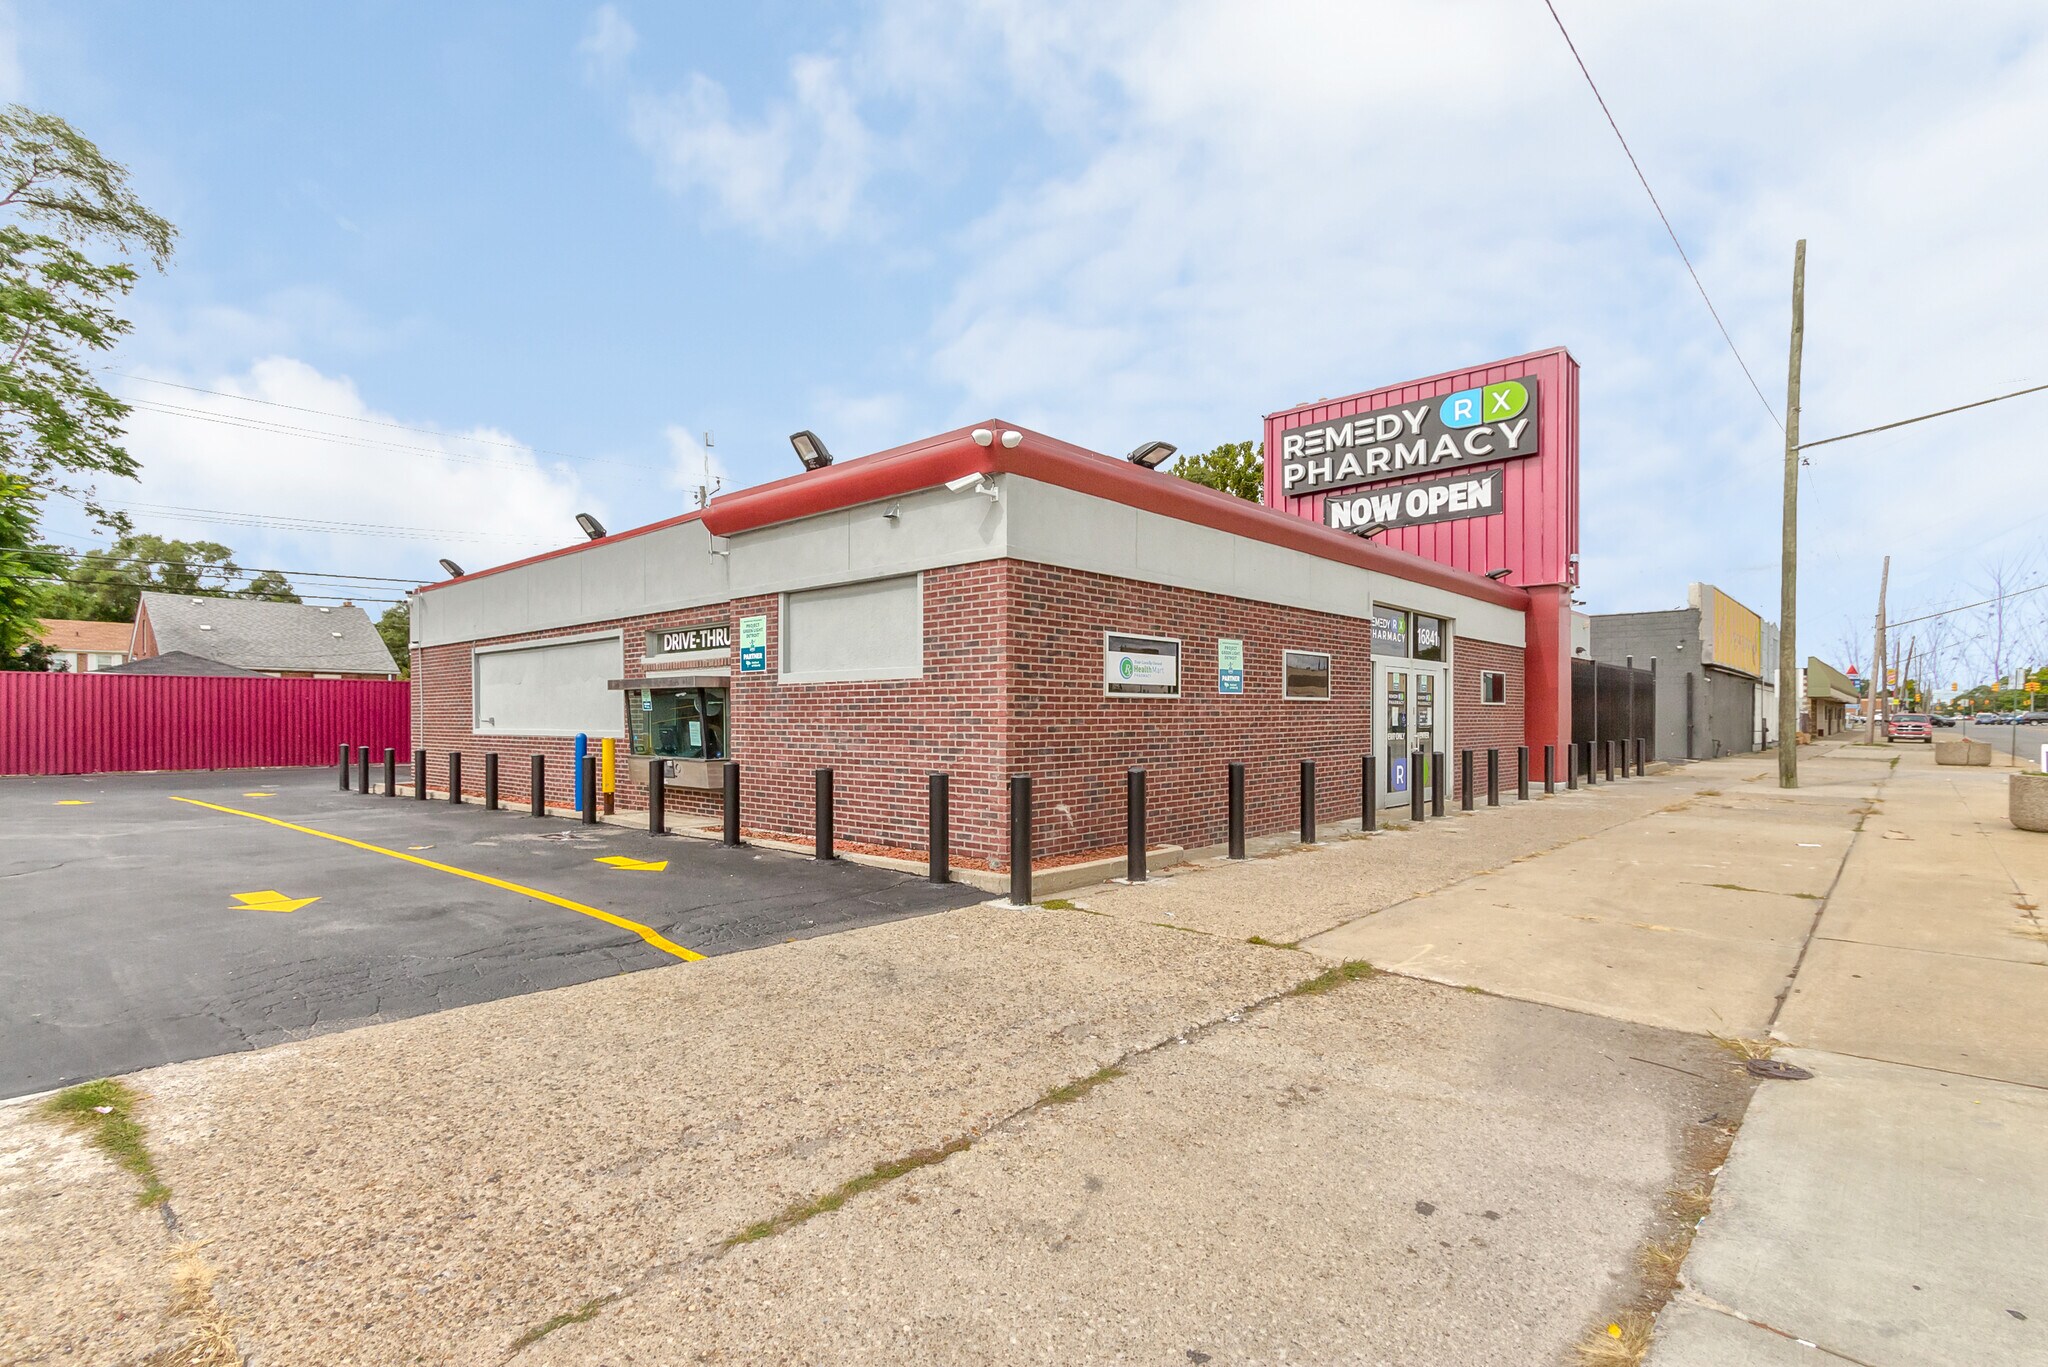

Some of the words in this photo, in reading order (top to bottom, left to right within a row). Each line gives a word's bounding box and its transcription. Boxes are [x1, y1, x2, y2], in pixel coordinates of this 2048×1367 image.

[1283, 405, 1431, 460] REMEDY
[1284, 418, 1529, 489] PHARMACY
[1331, 491, 1402, 529] NOW
[1405, 477, 1492, 518] OPEN
[1371, 617, 1391, 629] EMEDY
[664, 628, 731, 651] DRIVE-THRU
[1372, 629, 1406, 643] HARMACY
[1417, 628, 1438, 646] 16841
[1396, 765, 1404, 785] R
